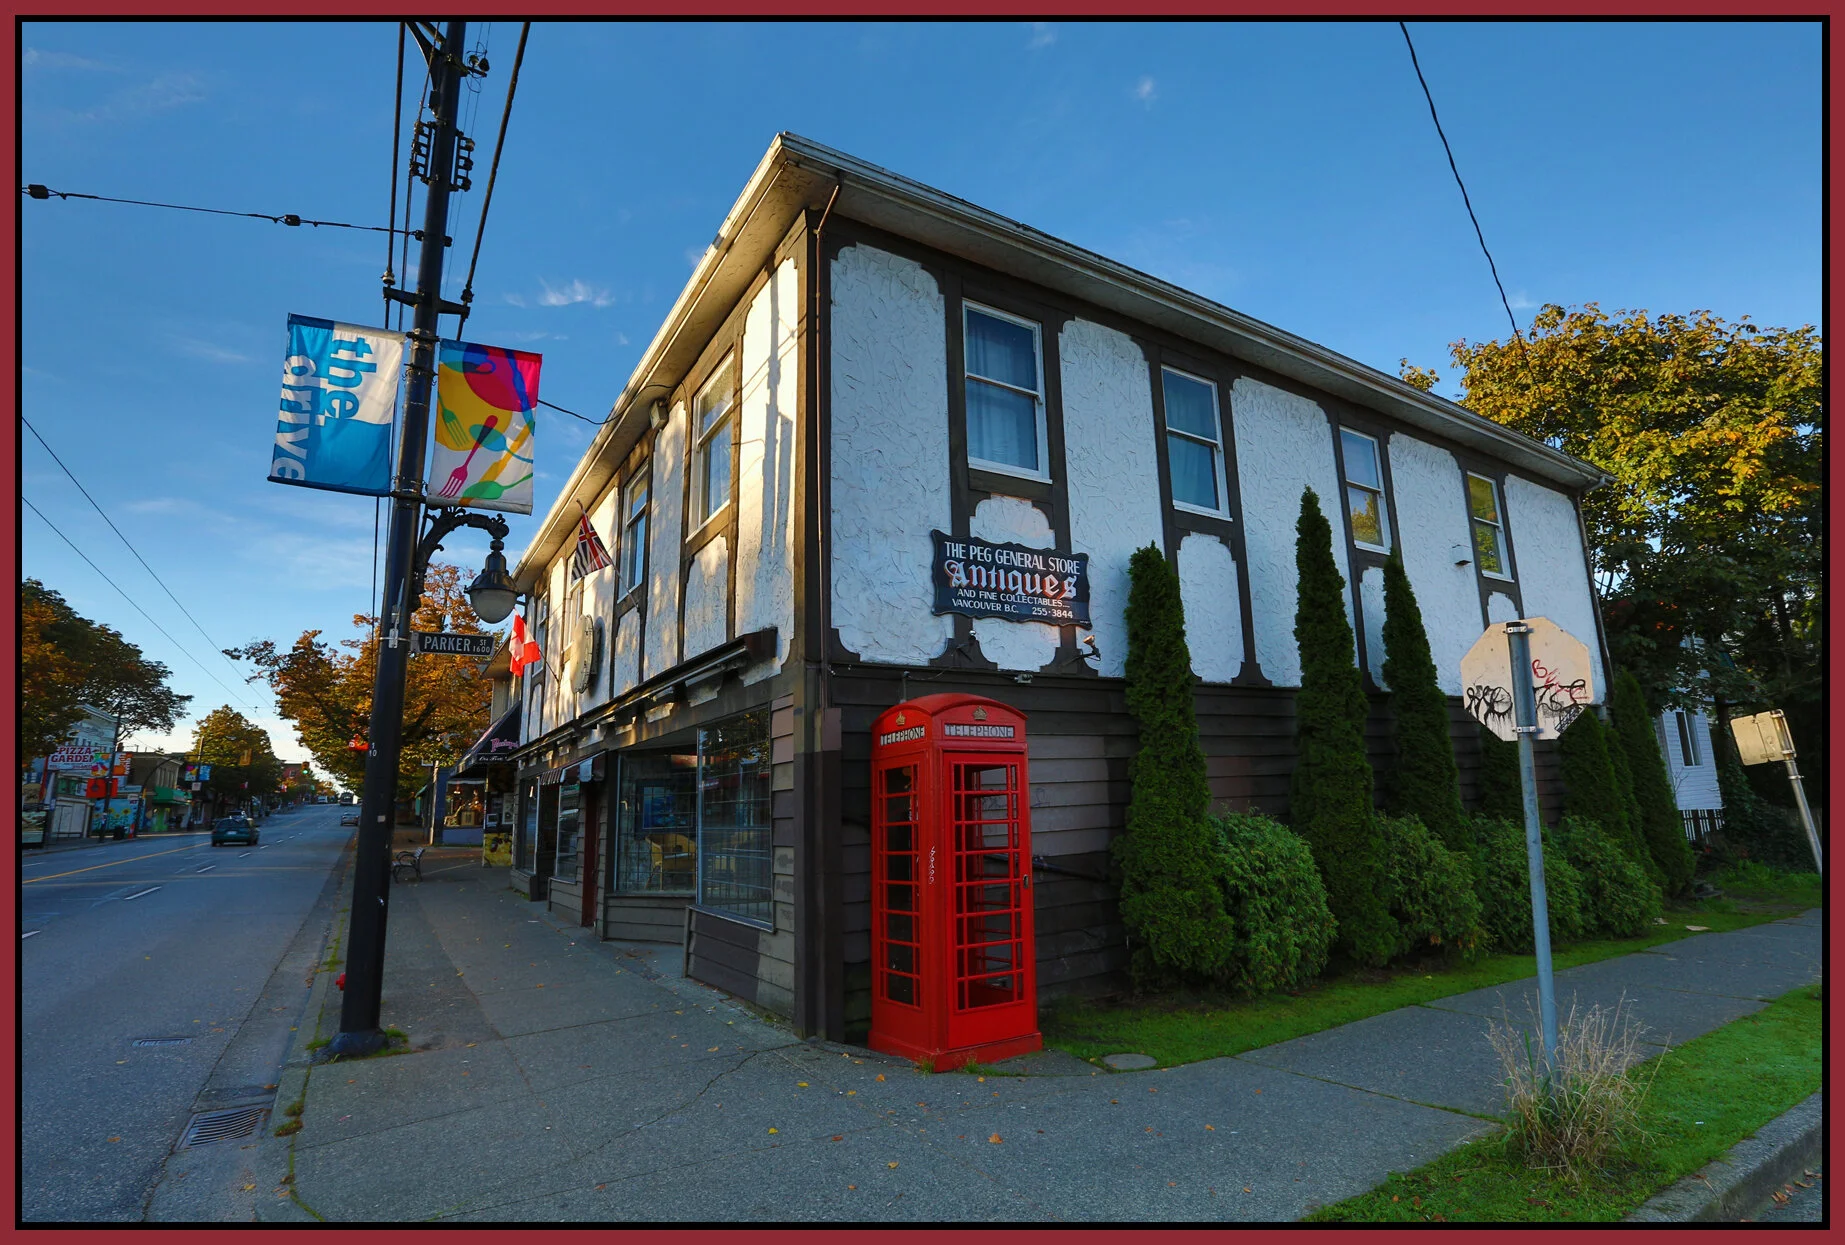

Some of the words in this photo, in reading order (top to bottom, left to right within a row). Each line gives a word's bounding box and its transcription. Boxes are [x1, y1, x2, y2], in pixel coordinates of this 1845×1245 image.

[326, 338, 377, 420] the
[272, 354, 328, 480] drive
[944, 541, 967, 560] THE
[969, 545, 992, 563] PEG
[995, 549, 1047, 571] GENERAL
[1048, 556, 1081, 575] STORE
[943, 559, 1078, 600] Antiques
[957, 588, 976, 598] AND
[979, 590, 998, 601] FINE
[952, 598, 1002, 612] VANCOUVER
[424, 635, 471, 652] PARKER
[472, 645, 490, 653] 1600
[880, 726, 925, 746] TELEPHONE
[944, 724, 1014, 738] TELEPHONE
